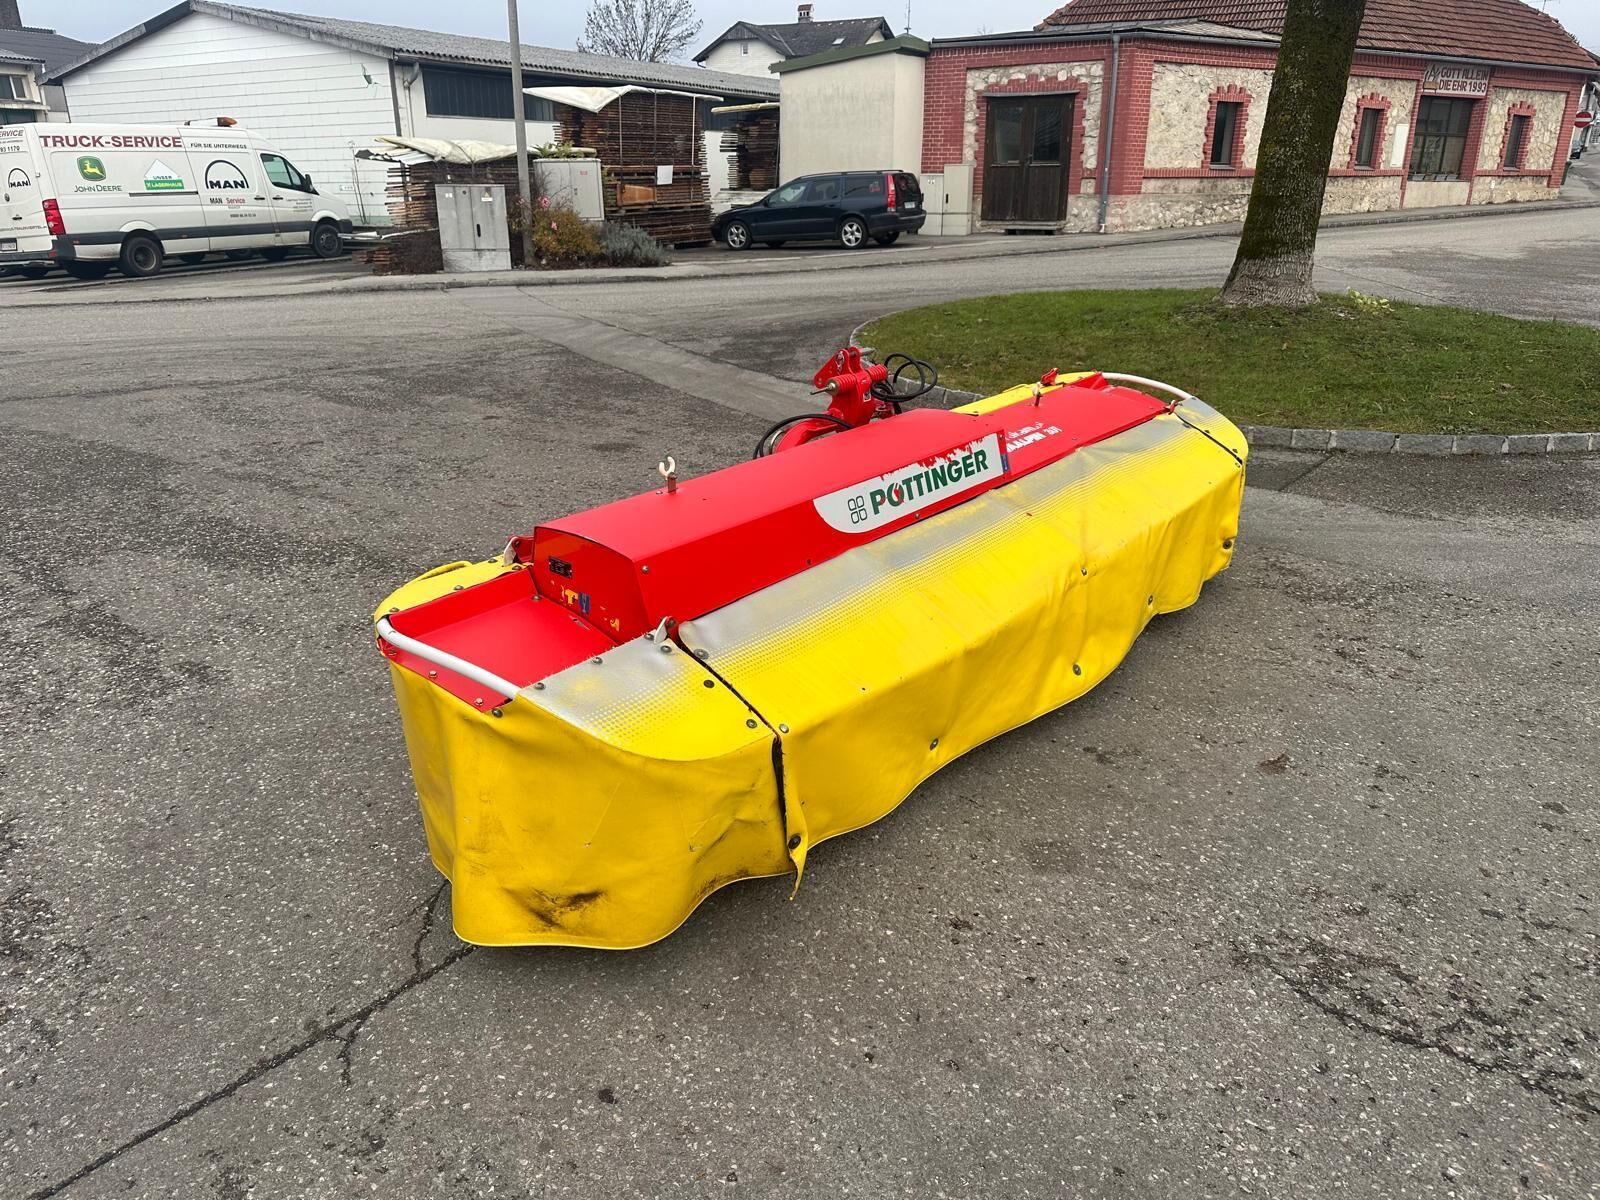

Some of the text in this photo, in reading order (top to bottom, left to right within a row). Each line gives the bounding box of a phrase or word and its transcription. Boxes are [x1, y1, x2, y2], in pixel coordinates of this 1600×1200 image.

[1440, 67, 1489, 81] GOTT ALLEIN
[1439, 80, 1487, 93] DIE EHR 1993
[39, 135, 182, 148] TRUCK-SERVICE
[208, 180, 245, 189] MAN
